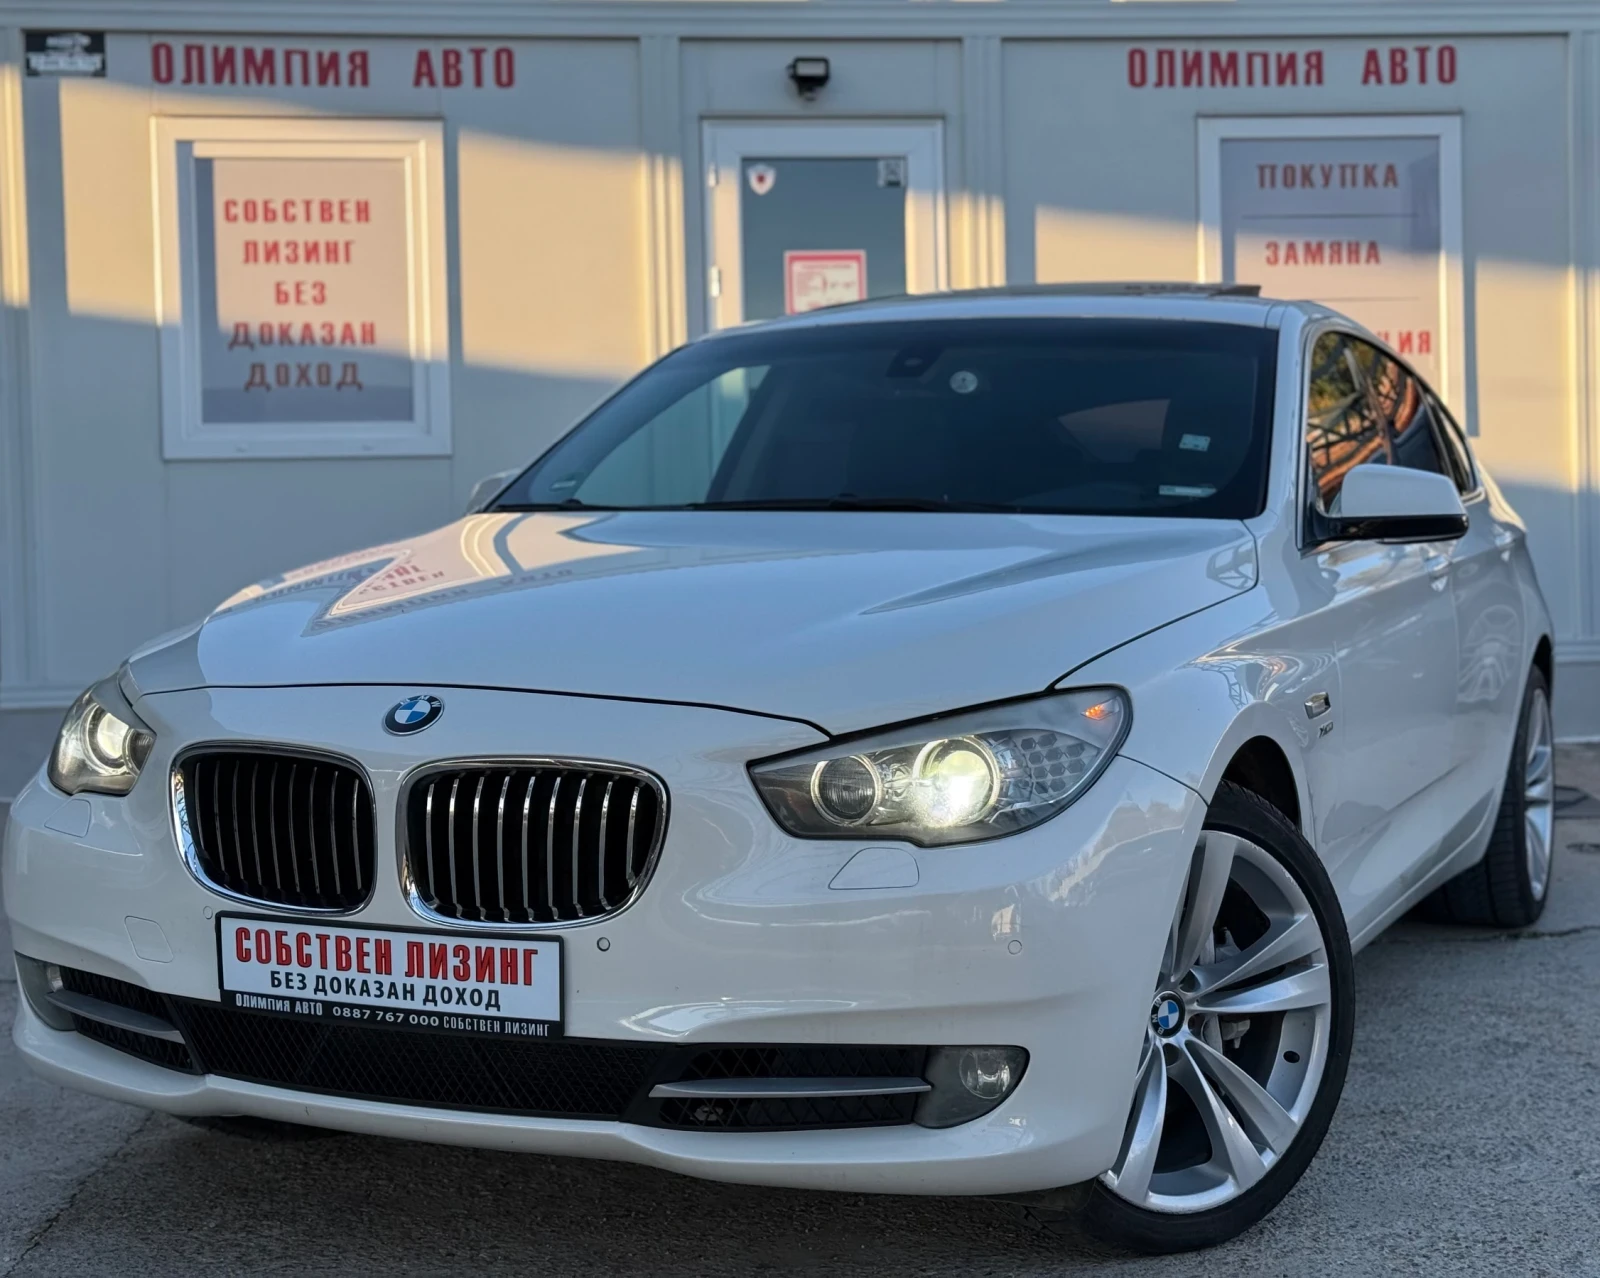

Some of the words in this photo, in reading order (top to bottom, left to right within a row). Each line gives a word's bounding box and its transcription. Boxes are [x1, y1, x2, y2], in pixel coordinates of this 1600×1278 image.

[151, 43, 370, 87] ОЛИМПИЯ
[413, 47, 516, 88] АВТО
[1127, 48, 1324, 88] ОЛИМПИЯ
[1361, 45, 1457, 85] АВТО
[1257, 163, 1399, 189] ПОКУПКА
[224, 199, 371, 223] СОБСТВЕН
[243, 241, 354, 264] ЛИЗИНГ
[1265, 241, 1381, 266] ЗАМЯНА
[274, 280, 327, 305] БЕЗ
[228, 322, 377, 351] ДОКАЗАН
[244, 362, 364, 391] ДОХОД
[235, 926, 393, 976] СОБСТВЕН
[404, 941, 538, 986] ЛИЗИНГ
[270, 970, 308, 991] БЕЗ
[313, 975, 415, 1001] ДОКАЗАН
[422, 984, 501, 1012] ДОХОД
[235, 993, 291, 1013] ОЛИМПИЯ
[294, 1001, 323, 1016] АВТО
[332, 1006, 371, 1020] 0887
[375, 1010, 404, 1023] 767
[409, 1014, 439, 1027] 000
[443, 1015, 500, 1033] СОБСТВЕН
[504, 1021, 550, 1037] ЛИЗИНГ
